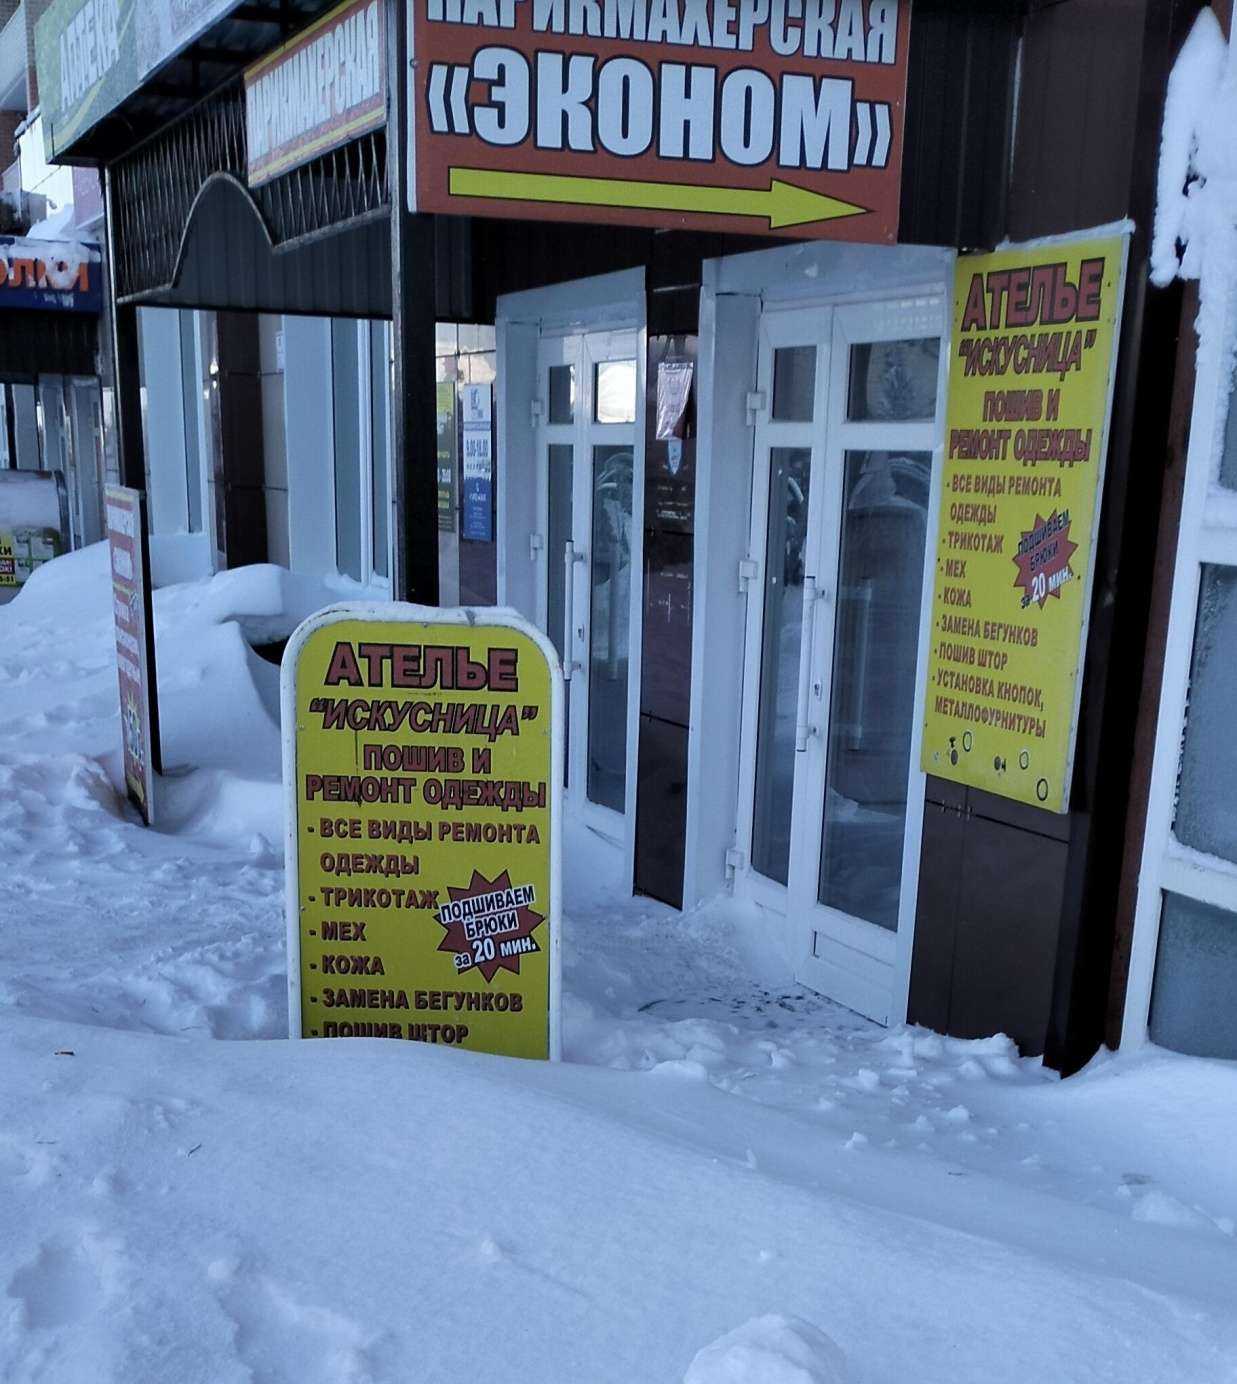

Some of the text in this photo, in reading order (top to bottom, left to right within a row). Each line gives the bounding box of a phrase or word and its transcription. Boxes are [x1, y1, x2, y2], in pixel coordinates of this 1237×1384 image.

[427, 46, 892, 171] «ЭКОНОМ»
[961, 257, 1105, 331] АТЕЛЬЕ
[983, 389, 1060, 422] ПОШИВ И
[949, 429, 1092, 467] РЕМОНТ ОДЕЖДЫ
[952, 474, 1061, 497] ВСЕ ВИДЫ РЕМОНТА
[951, 503, 996, 525] ОДЕЖДЫ
[948, 531, 1003, 554] ТРИКОТАЖ
[1018, 508, 1069, 555] ПОДШИВАЕМ
[946, 559, 966, 578] МЕХ
[943, 588, 971, 608] КОЖА
[1032, 573, 1046, 602] 20
[941, 615, 1038, 647] ЗАМЕНА БЕГУНКОВ
[324, 642, 518, 692] АТЕЛЬЕ
[938, 642, 1008, 670] ПОШИВ ШТОР
[937, 669, 1044, 711] УСТАНОВКА КНОПОК,
[934, 695, 1046, 738] МЕТАЛЛОФУРНИТУРЫ
[364, 744, 492, 774] ПОШИВ И
[306, 775, 546, 811] РЕМОНТ ОДЕЖДЫ
[320, 818, 540, 845] ВСЕ ВИДЫ РЕМОНТА
[320, 853, 419, 876] ОДЕЖДЫ
[320, 887, 439, 910] ТРИКОТАЖ
[440, 885, 535, 922] ПОДШИВАЕМ
[321, 921, 366, 942] МЕХ
[465, 911, 518, 939] БРЮКИ
[321, 954, 385, 976] КОЖА
[454, 953, 471, 967] за
[472, 938, 495, 963] 20
[323, 988, 523, 1012] ЗАМЕНА БЕГУНКОВ
[323, 1021, 469, 1044] ПОШИВ ШТОР
